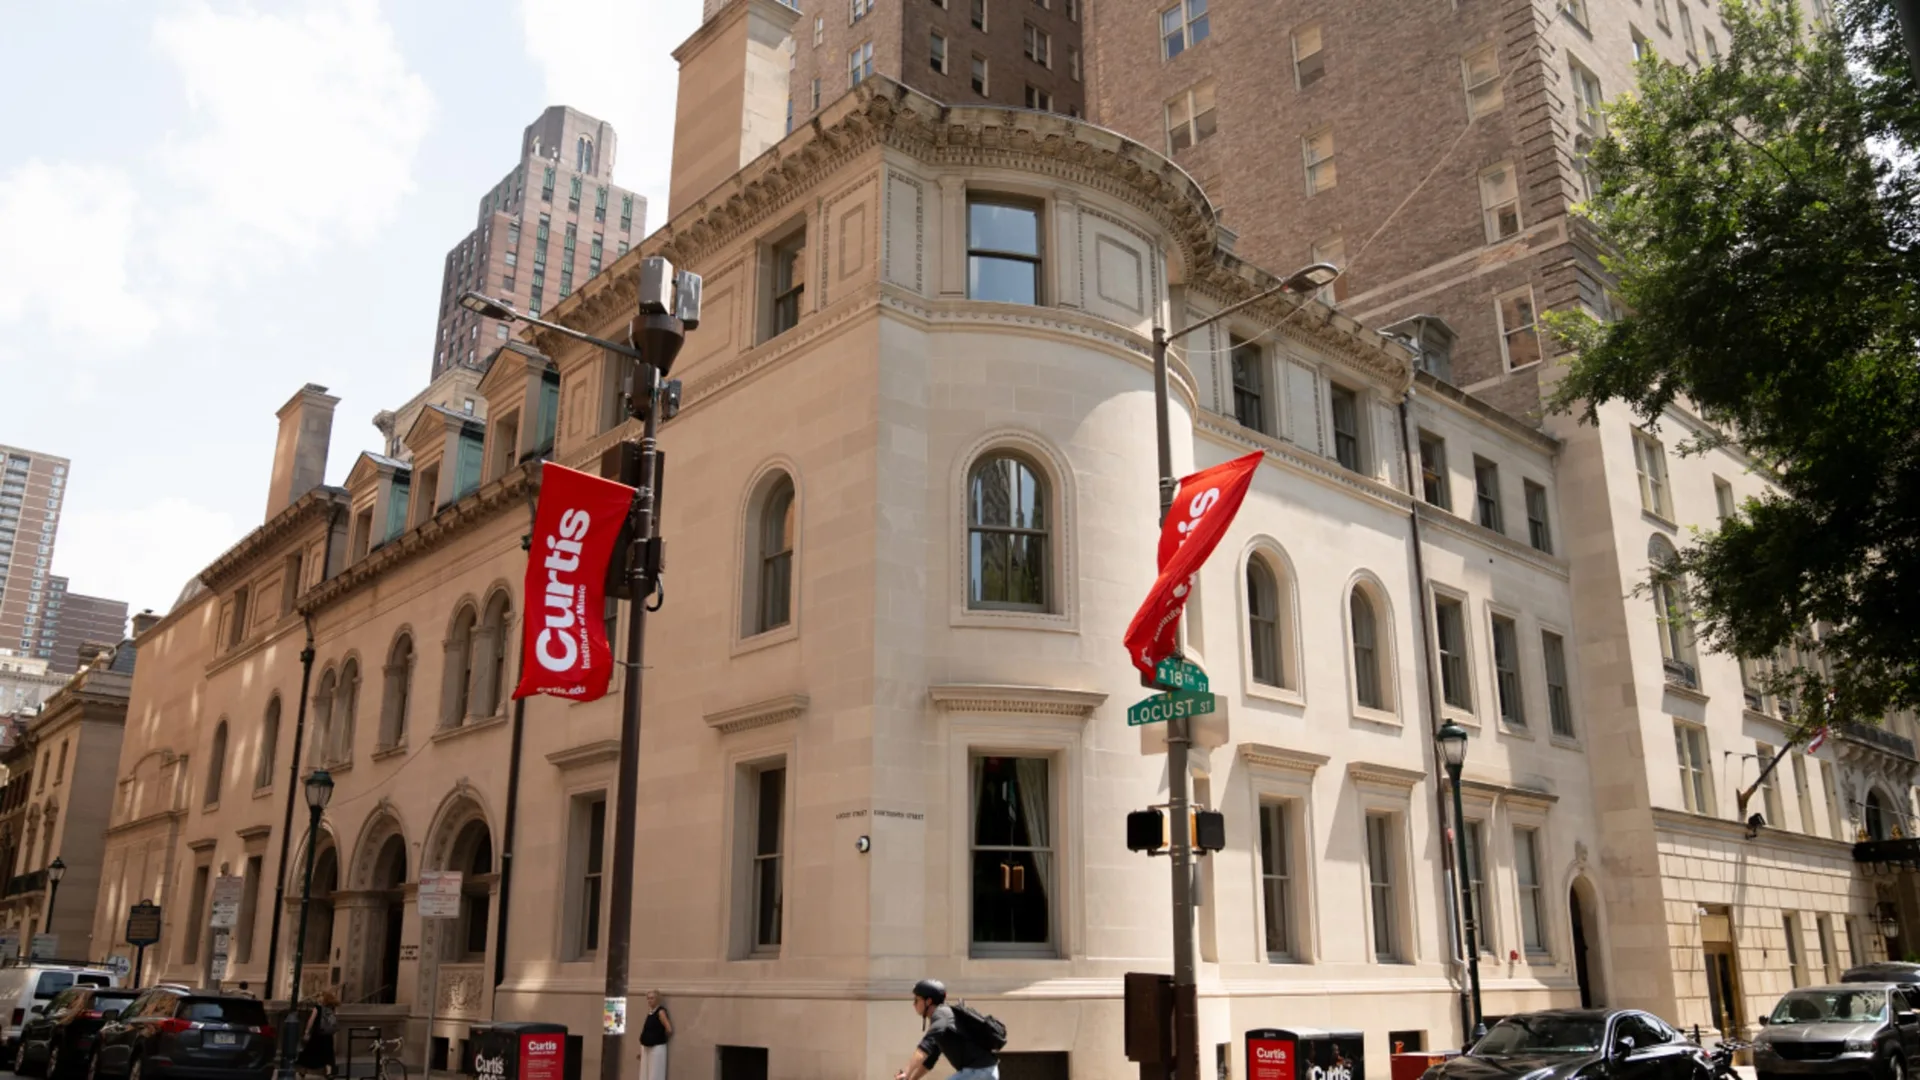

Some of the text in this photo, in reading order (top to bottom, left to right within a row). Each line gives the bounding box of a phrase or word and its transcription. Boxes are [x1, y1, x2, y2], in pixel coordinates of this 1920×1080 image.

[535, 507, 591, 673] Curtis
[576, 584, 587, 614] Music
[580, 628, 591, 670] Institute
[1169, 669, 1195, 686] 18TH
[1198, 681, 1207, 692] ST
[1130, 698, 1211, 724] LOCUST ST
[528, 1041, 557, 1051] Curtis
[1256, 1047, 1287, 1059] Curtis
[475, 1054, 505, 1075] Curtis
